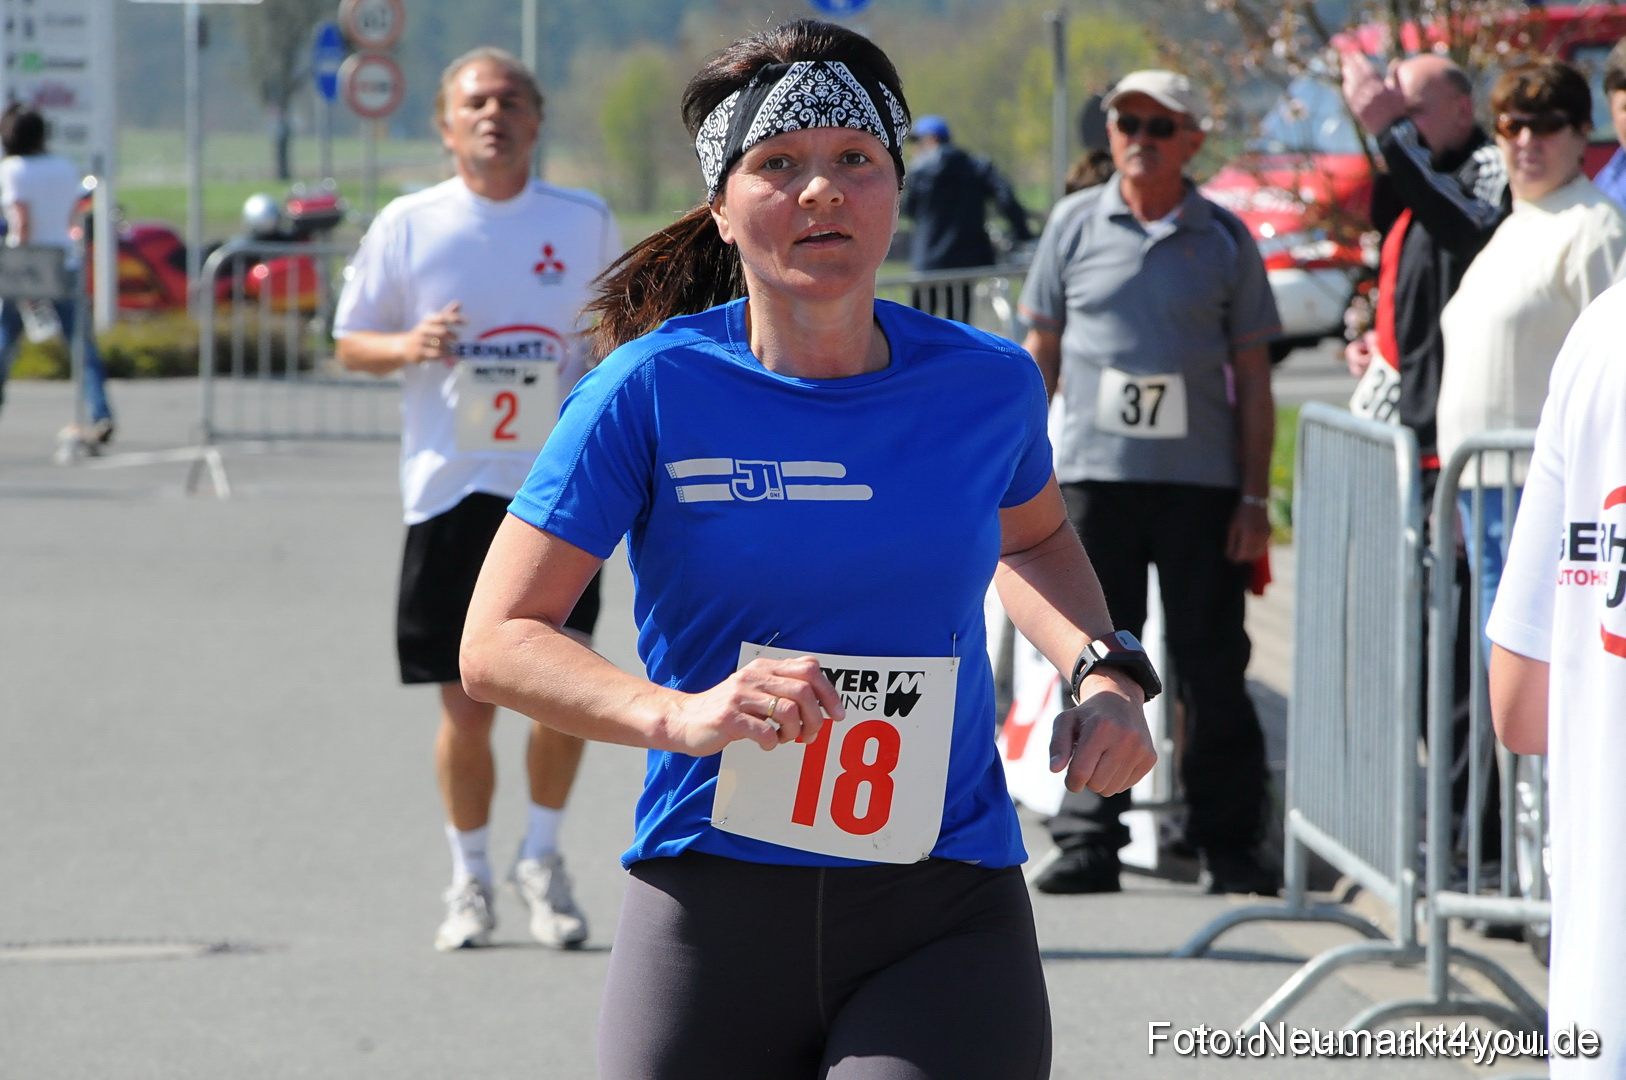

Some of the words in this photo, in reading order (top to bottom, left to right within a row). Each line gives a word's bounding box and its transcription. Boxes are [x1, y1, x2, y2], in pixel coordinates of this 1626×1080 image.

[493, 391, 519, 442] 2
[1121, 383, 1167, 426] 37
[791, 718, 901, 835] 18
